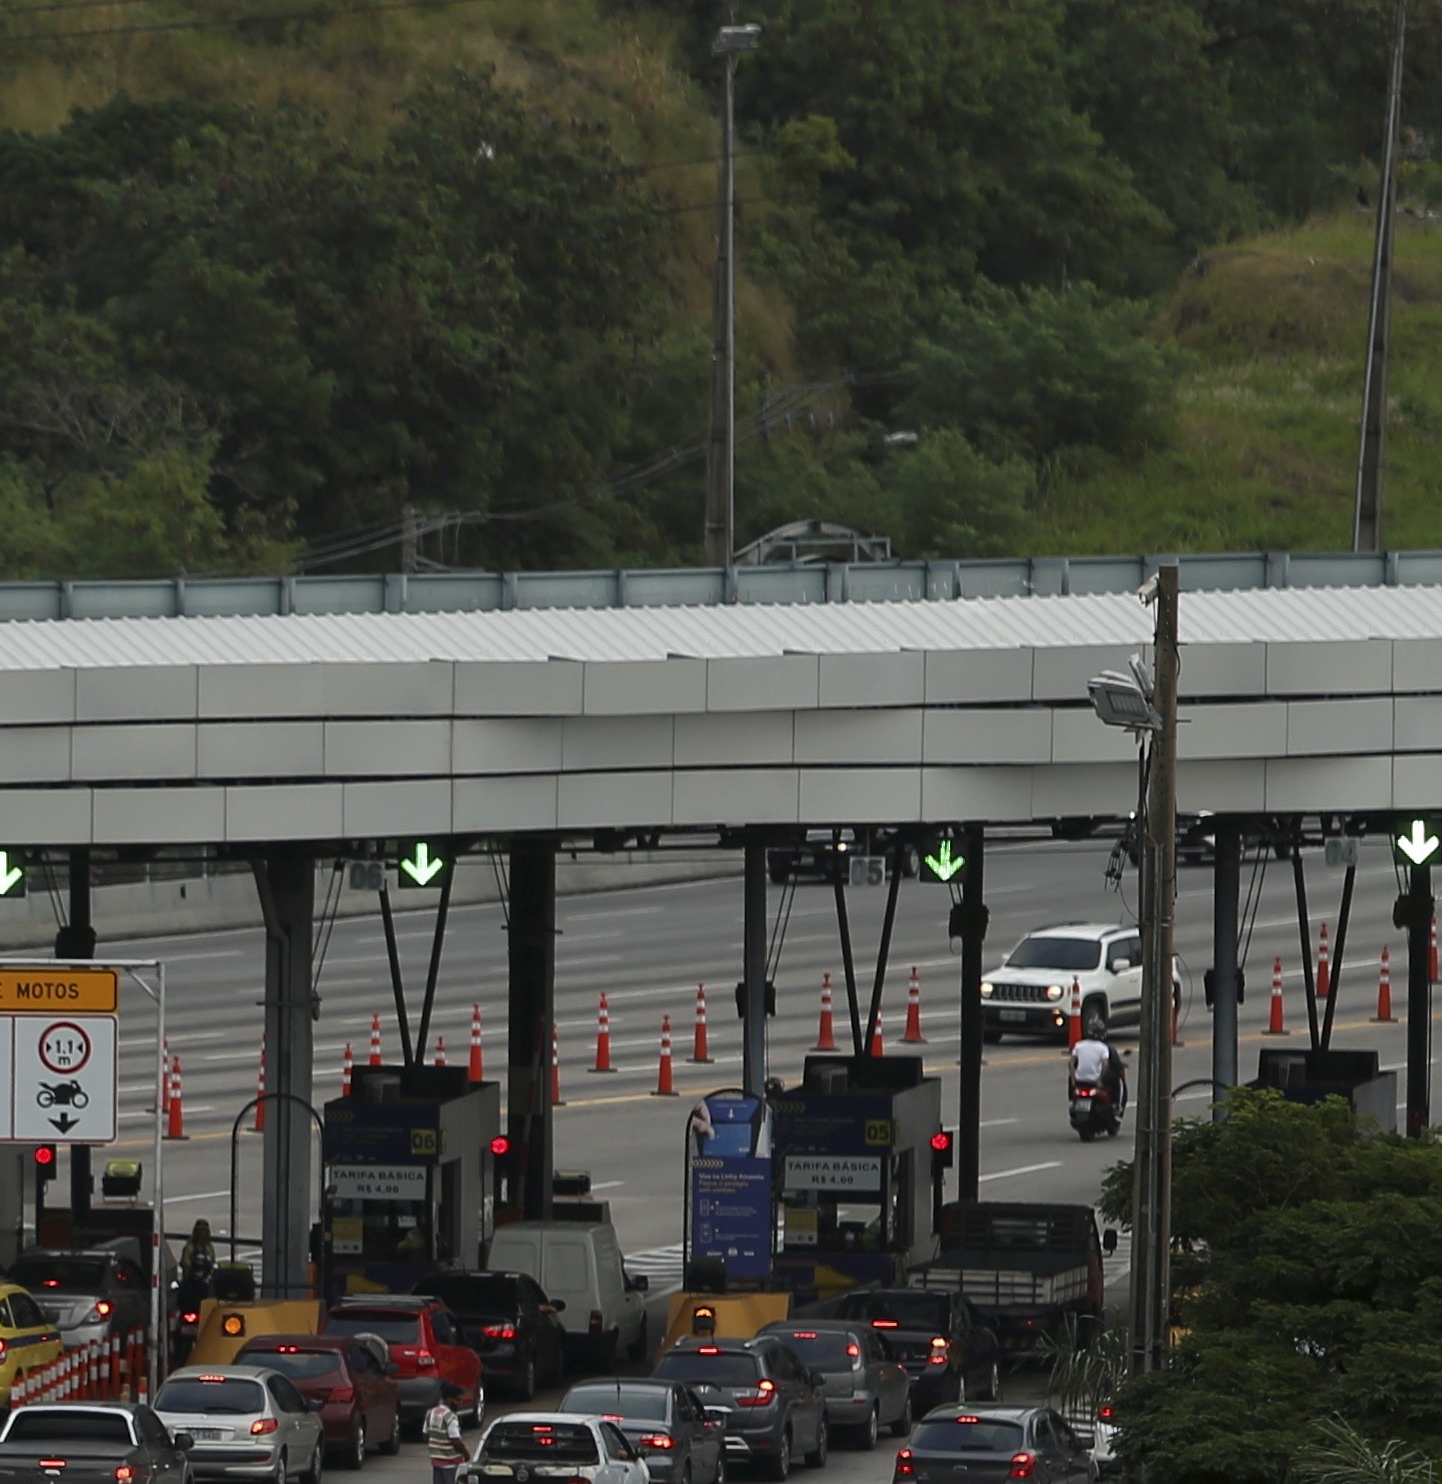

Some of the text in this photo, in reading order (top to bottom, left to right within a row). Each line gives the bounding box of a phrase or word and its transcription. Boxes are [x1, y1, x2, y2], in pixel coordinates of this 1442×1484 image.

[350, 862, 382, 889] 06
[851, 859, 883, 886] 05
[17, 983, 80, 999] MOTOS
[58, 1056, 71, 1065] m
[868, 1126, 889, 1140] 05
[412, 1134, 435, 1149] 06
[788, 1160, 879, 1171] TARIFA BÁSICA
[333, 1171, 376, 1179] TARIFA
